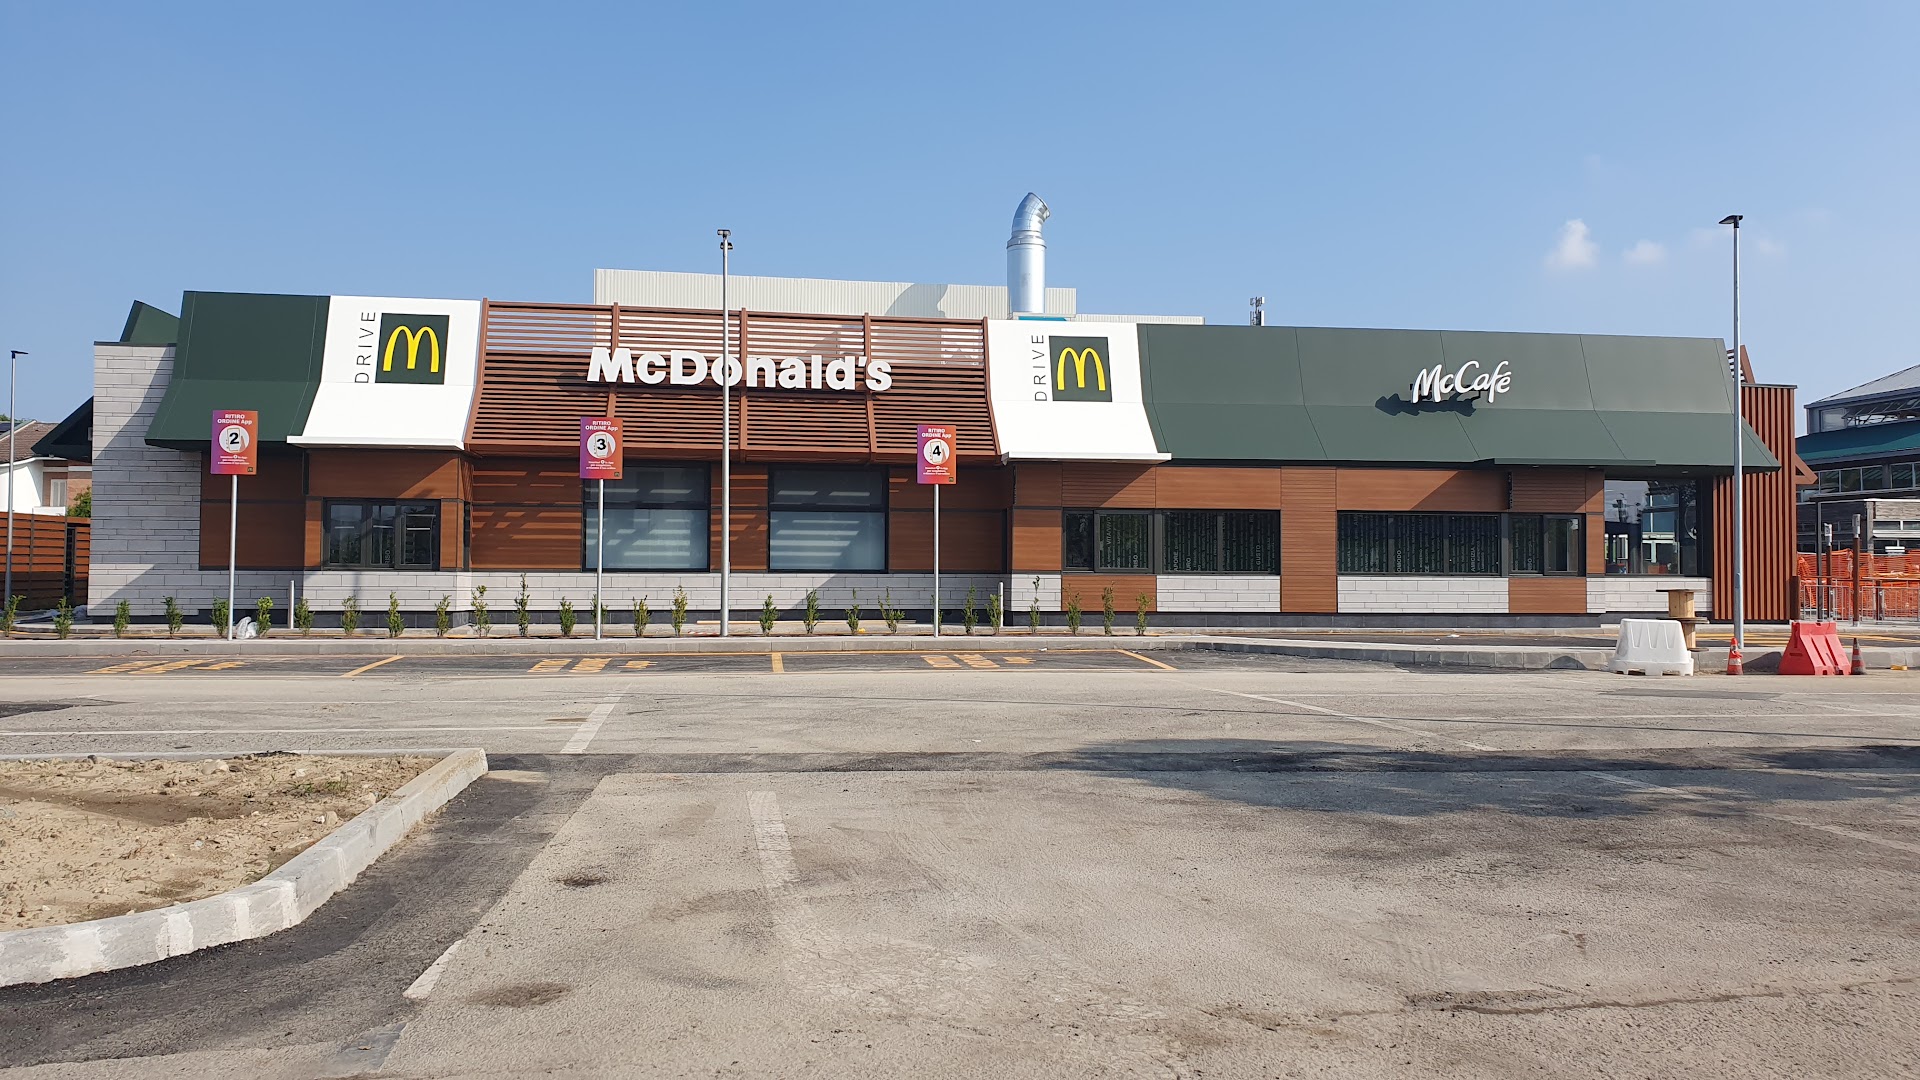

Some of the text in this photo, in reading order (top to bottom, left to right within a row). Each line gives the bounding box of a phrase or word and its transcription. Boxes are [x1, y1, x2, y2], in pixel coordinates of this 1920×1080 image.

[354, 311, 376, 383] DRIVE
[1031, 335, 1048, 401] DRIVE
[587, 347, 893, 391] McDonald's
[1411, 360, 1512, 403] McCafé
[229, 432, 240, 444] 2
[596, 438, 607, 450] 3
[932, 445, 942, 457] 4
